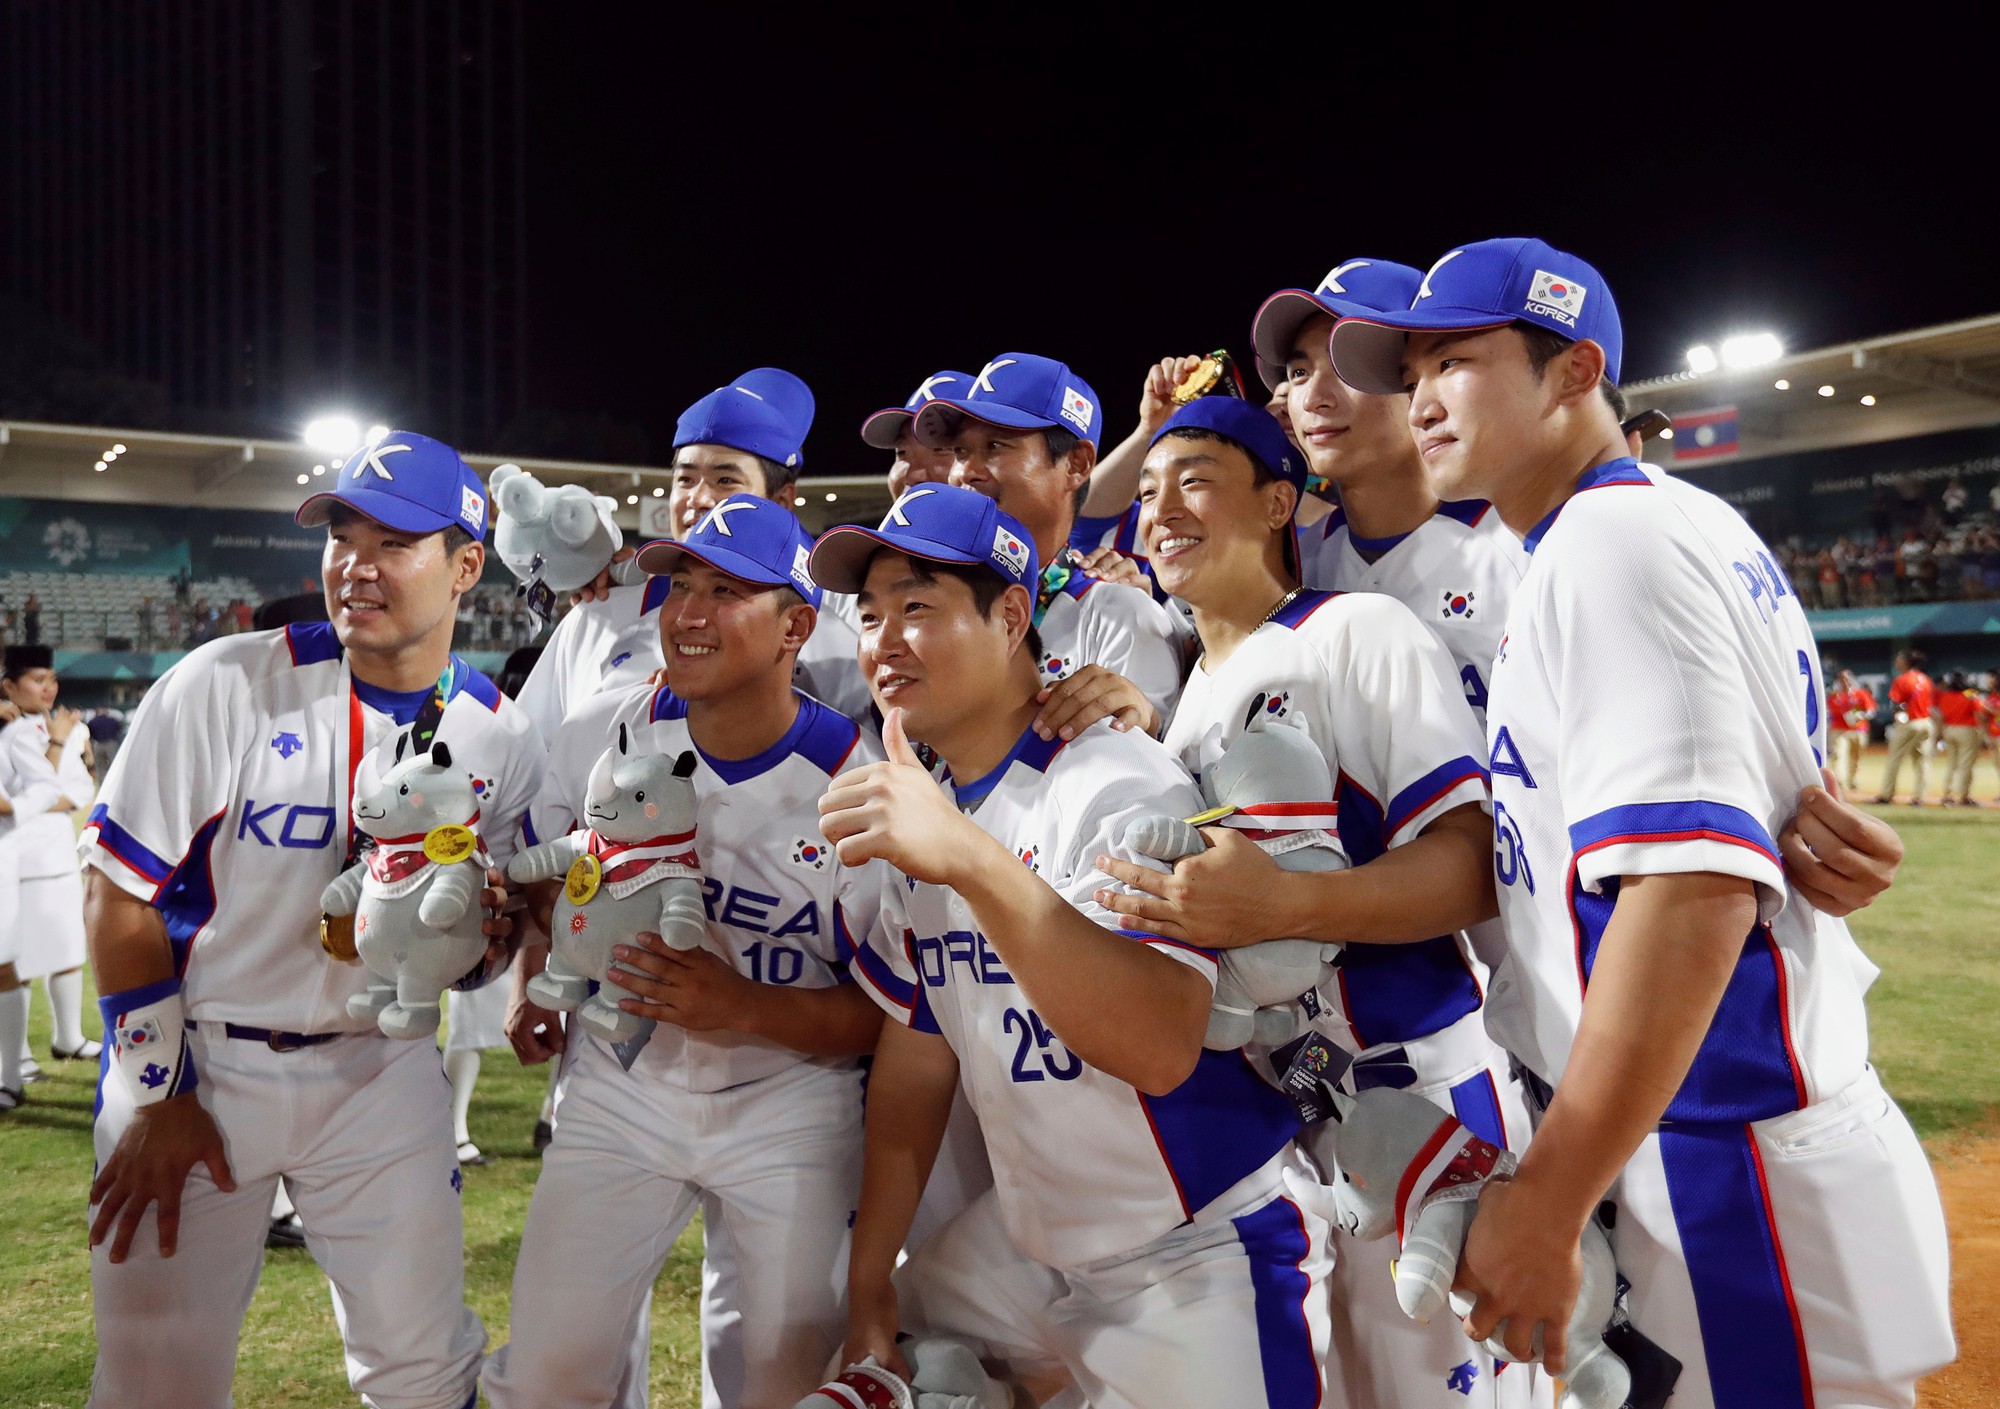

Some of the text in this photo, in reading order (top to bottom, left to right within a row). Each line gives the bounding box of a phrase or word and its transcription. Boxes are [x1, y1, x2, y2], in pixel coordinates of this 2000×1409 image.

[1314, 261, 1371, 295] K
[1524, 301, 1575, 329] KOREA
[909, 376, 956, 407] K
[966, 359, 1018, 400] K
[1060, 409, 1087, 435] KOREA
[352, 440, 413, 481] K
[460, 510, 482, 533] KOREA
[696, 498, 759, 537] K
[878, 489, 938, 532] K
[789, 568, 816, 597] KOREA
[990, 550, 1023, 582] KOREA
[1490, 724, 1538, 788] A
[238, 799, 337, 849] KO
[741, 941, 804, 984] 10
[1003, 1007, 1083, 1083] 25
[1289, 1078, 1304, 1091] 2018
[1295, 1068, 1317, 1086] Jakarta
